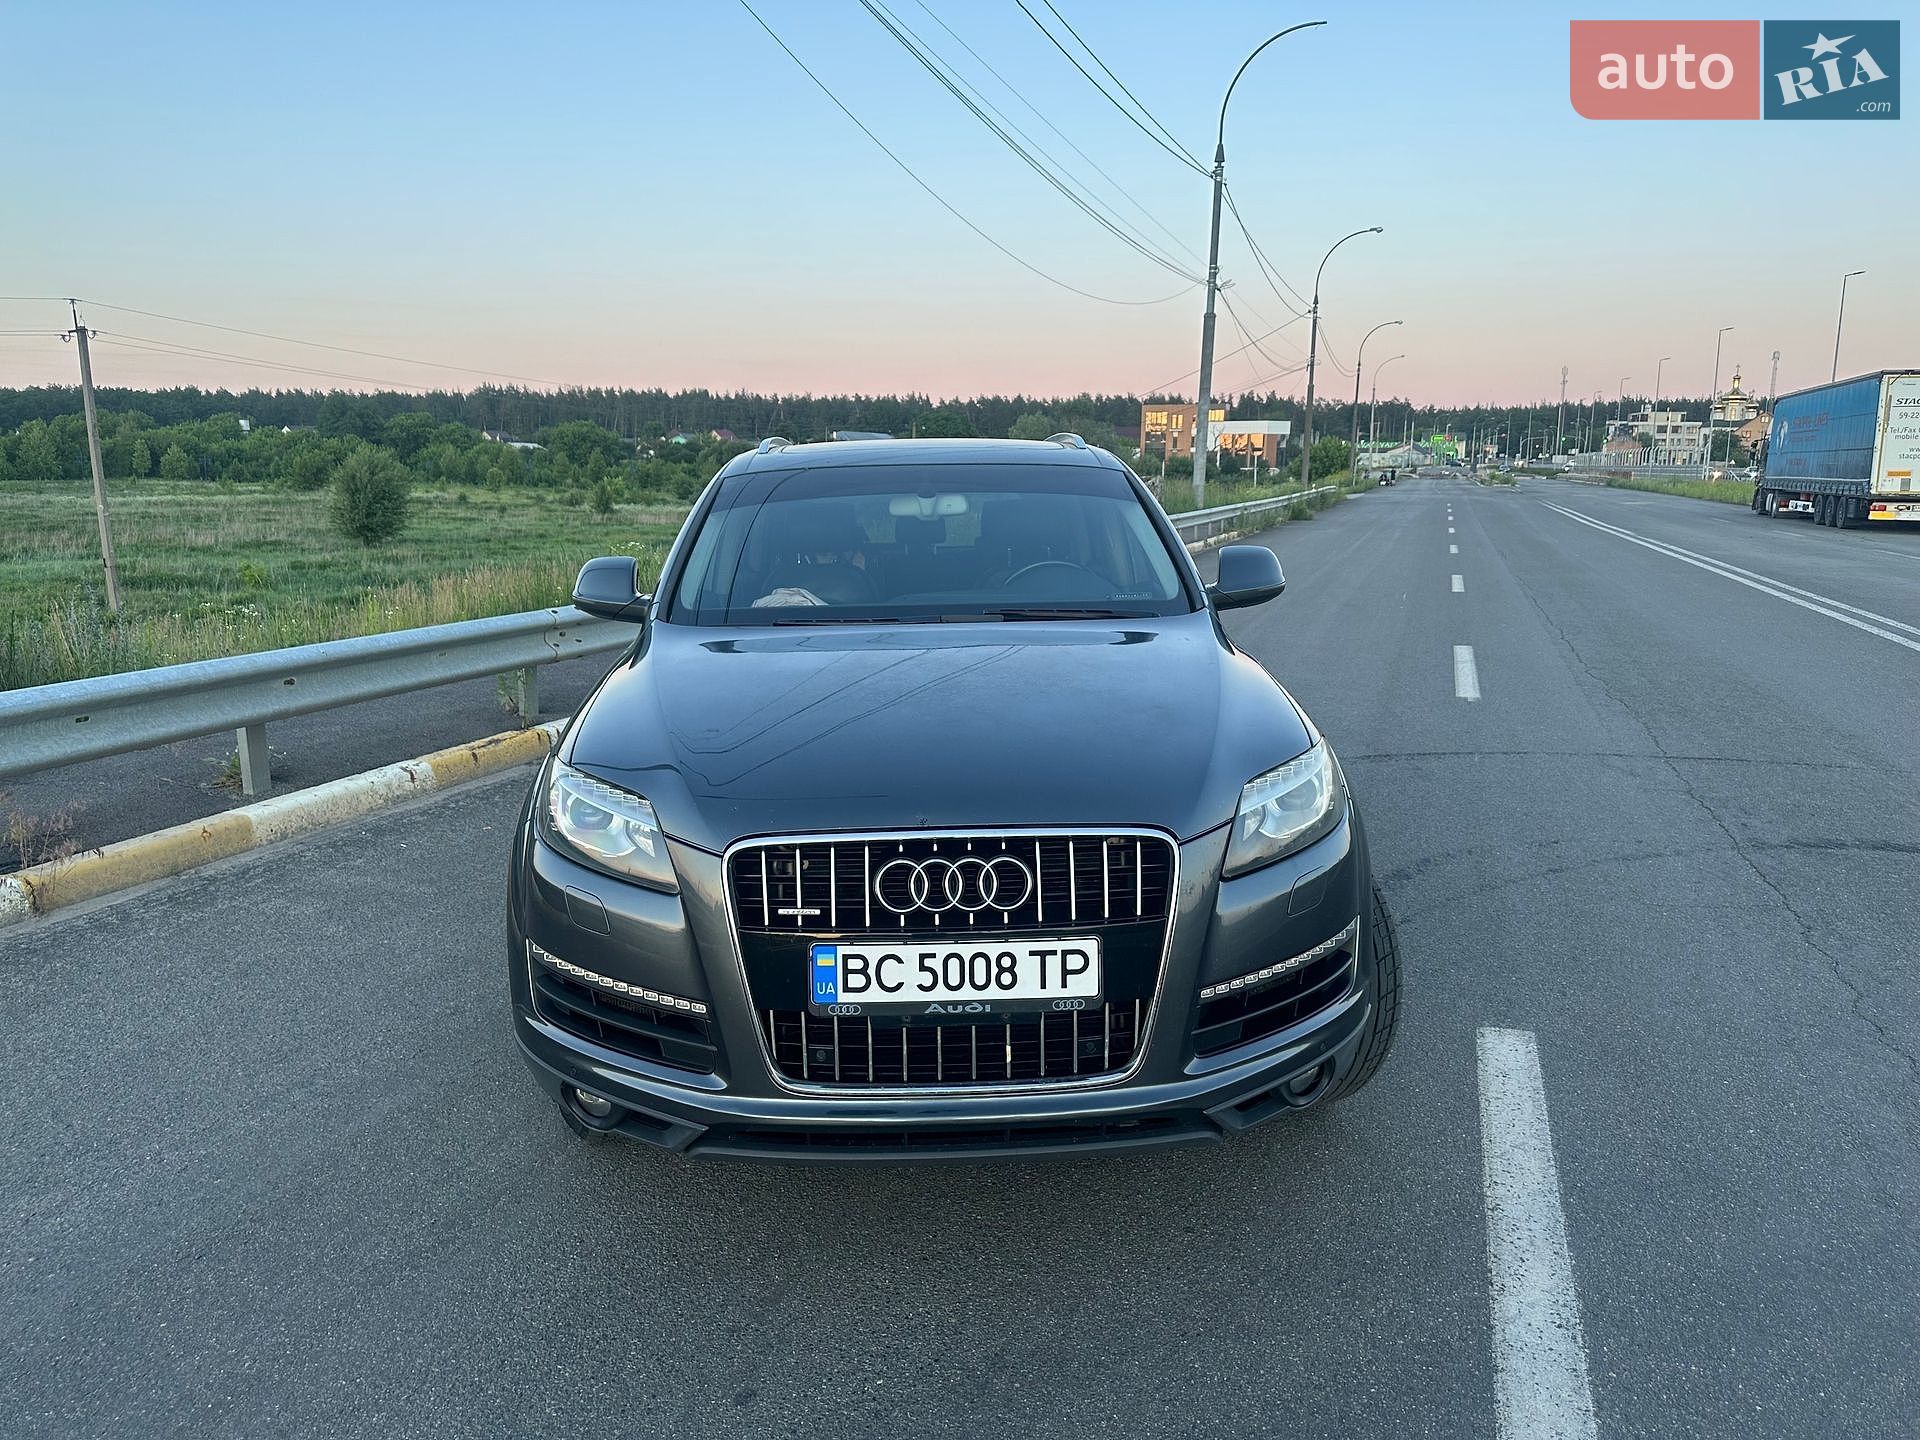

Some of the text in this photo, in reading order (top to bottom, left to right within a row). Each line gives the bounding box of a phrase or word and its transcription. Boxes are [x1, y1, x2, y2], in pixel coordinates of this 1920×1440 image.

[841, 948, 1090, 994] BC 5008 TP
[817, 983, 836, 995] UA
[924, 1001, 991, 1014] Audi
